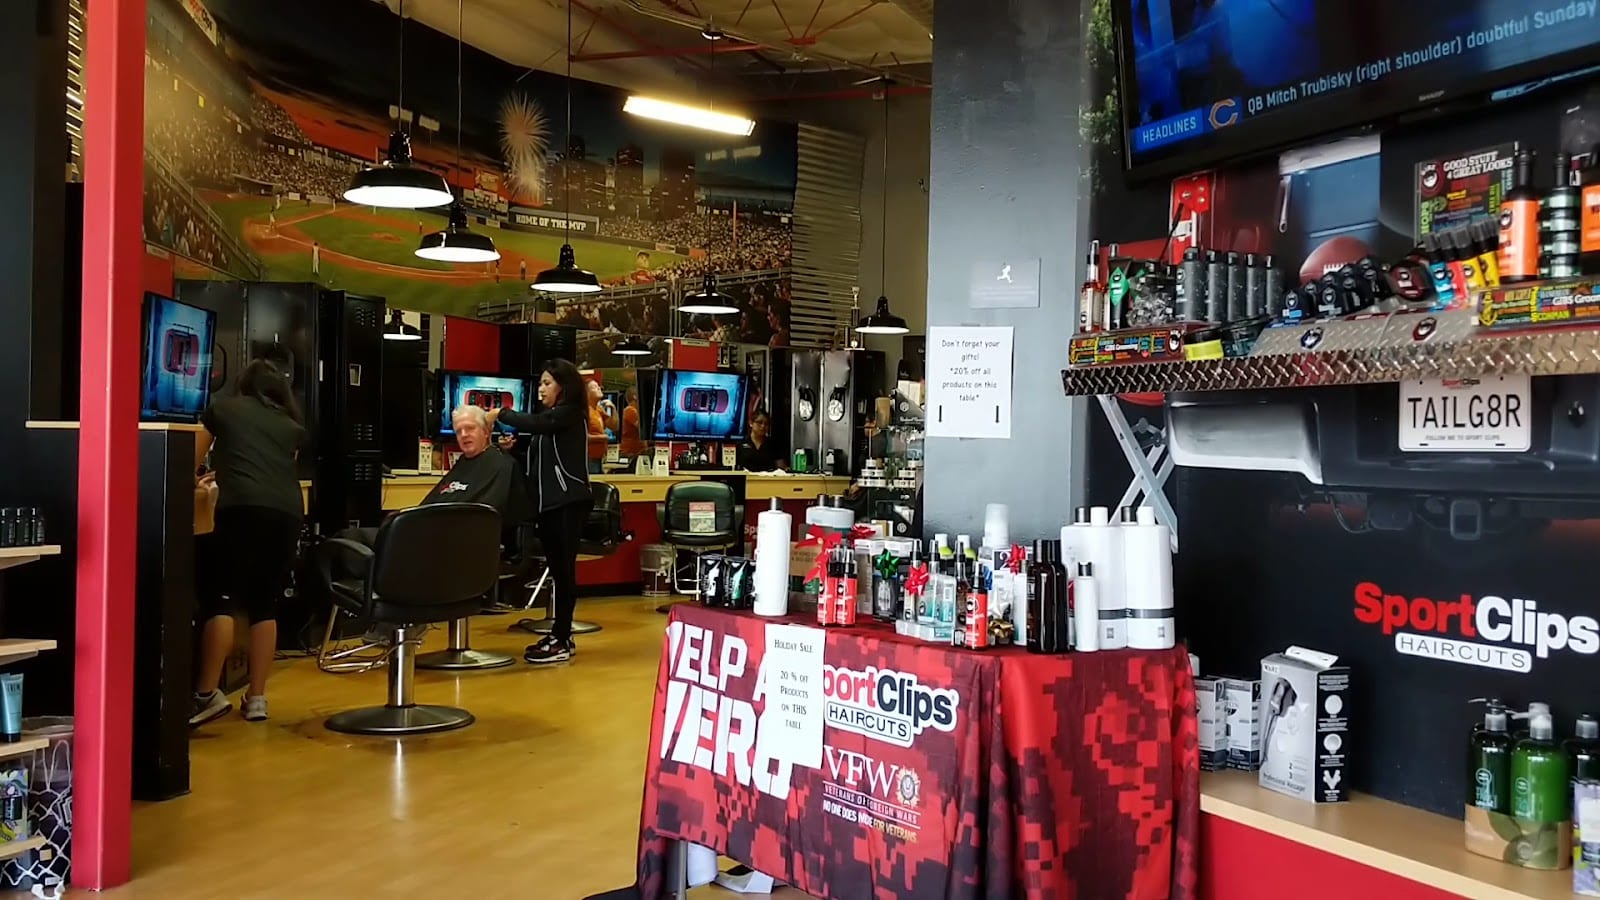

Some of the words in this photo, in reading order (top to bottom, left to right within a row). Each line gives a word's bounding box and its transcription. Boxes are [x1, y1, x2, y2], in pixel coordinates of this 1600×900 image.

[1247, 96, 1263, 115] QB
[1267, 85, 1298, 108] Mitch
[1301, 70, 1353, 98] Trubisky
[1357, 59, 1392, 83] (right
[1396, 36, 1463, 70] shoulder)
[1467, 15, 1530, 50] doubtful
[1534, 0, 1597, 29] Sunday
[1142, 116, 1197, 144] HEADLINES
[1443, 158, 1469, 173] GOOD
[1469, 151, 1499, 166] STUFF
[1446, 170, 1453, 180] 4
[1453, 164, 1482, 179] GREAT
[1483, 157, 1514, 172] LOOKS
[515, 214, 538, 226] HOME
[539, 217, 550, 227] OF
[551, 218, 567, 229] THE
[568, 221, 587, 231] MVP
[941, 340, 960, 348] Don't
[962, 340, 983, 349] forget
[985, 340, 1001, 349] your
[942, 381, 973, 389] products
[984, 381, 998, 389] this
[971, 367, 982, 375] off
[1407, 394, 1521, 429] TAILG8R
[1354, 581, 1600, 659] SportClips
[1400, 636, 1526, 669] HAIRCUTS
[780, 670, 789, 680] 20
[792, 703, 807, 715] THIS
[824, 670, 953, 729] portClips
[829, 705, 908, 738] HAIRCUTS
[823, 744, 900, 798] VFW
[823, 799, 831, 812] NO
[831, 802, 841, 817] ONE
[842, 805, 857, 822] DOES
[873, 818, 885, 833] FOR
[824, 784, 855, 802] VETERANS
[896, 809, 918, 825] WARS
